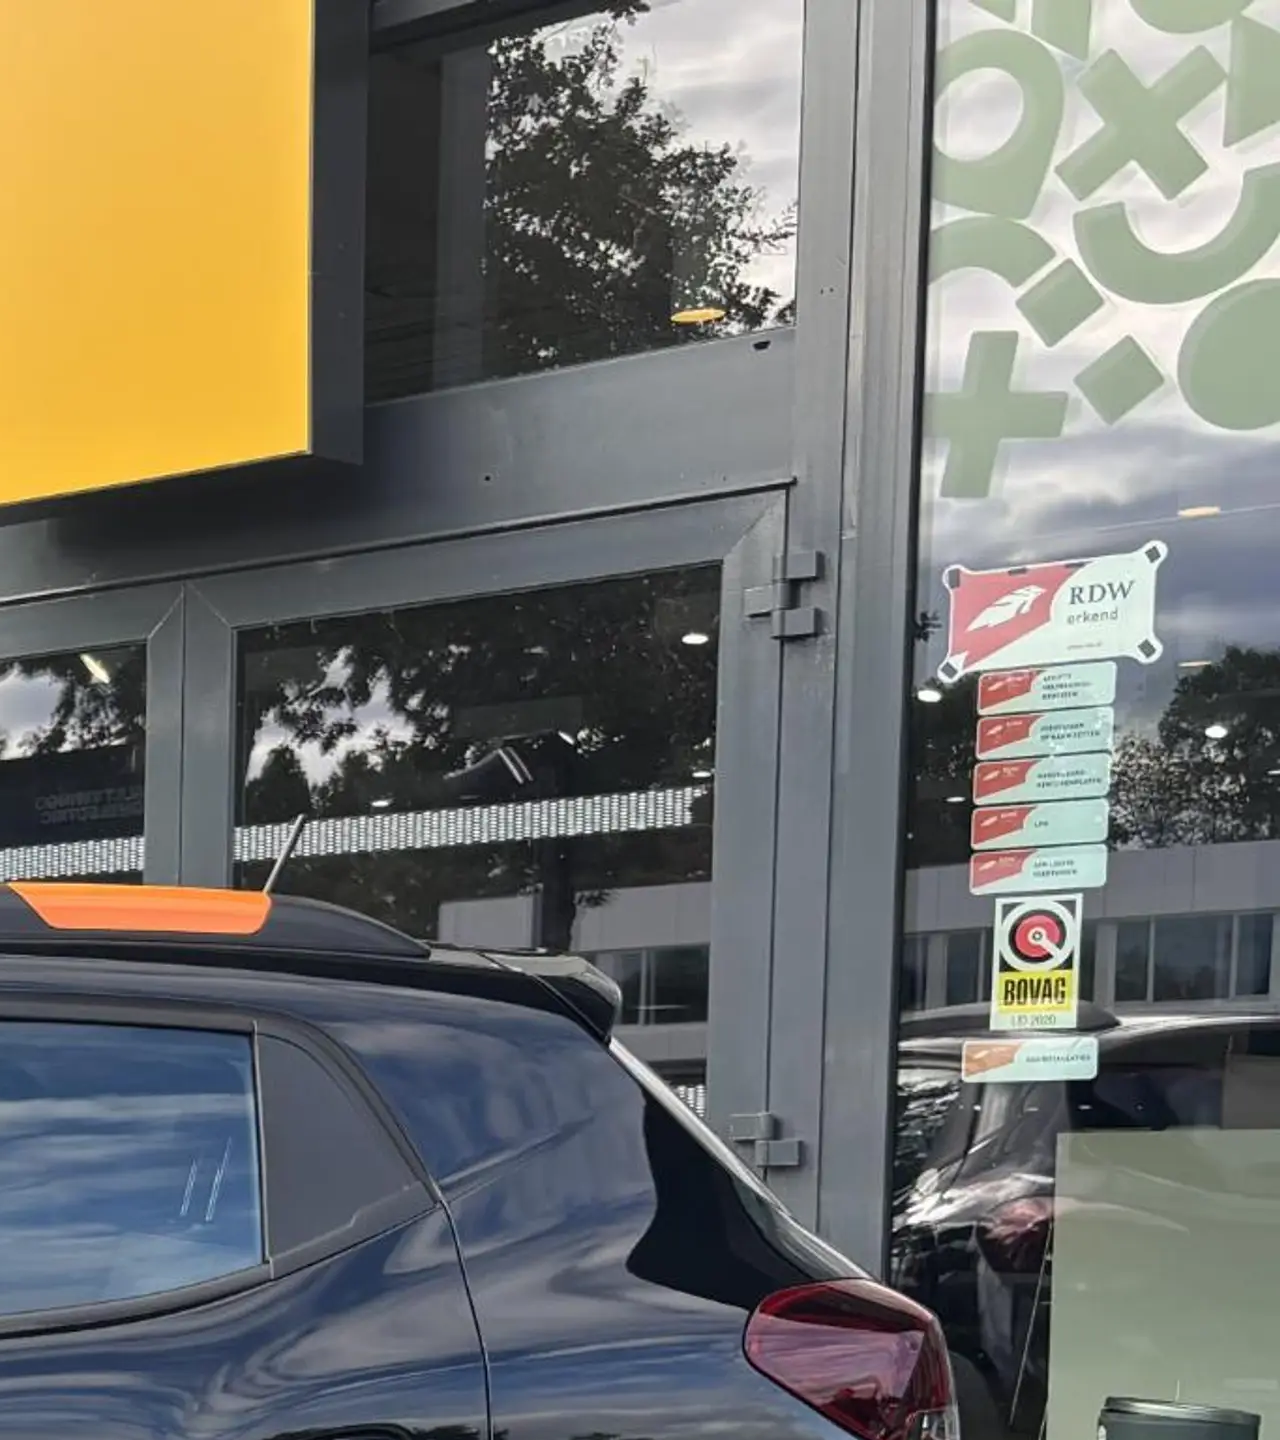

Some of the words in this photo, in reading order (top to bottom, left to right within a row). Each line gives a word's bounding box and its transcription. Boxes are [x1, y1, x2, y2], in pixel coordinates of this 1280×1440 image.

[1069, 579, 1136, 605] RDW
[1067, 606, 1119, 625] erkend
[1003, 977, 1066, 1009] BOVAG
